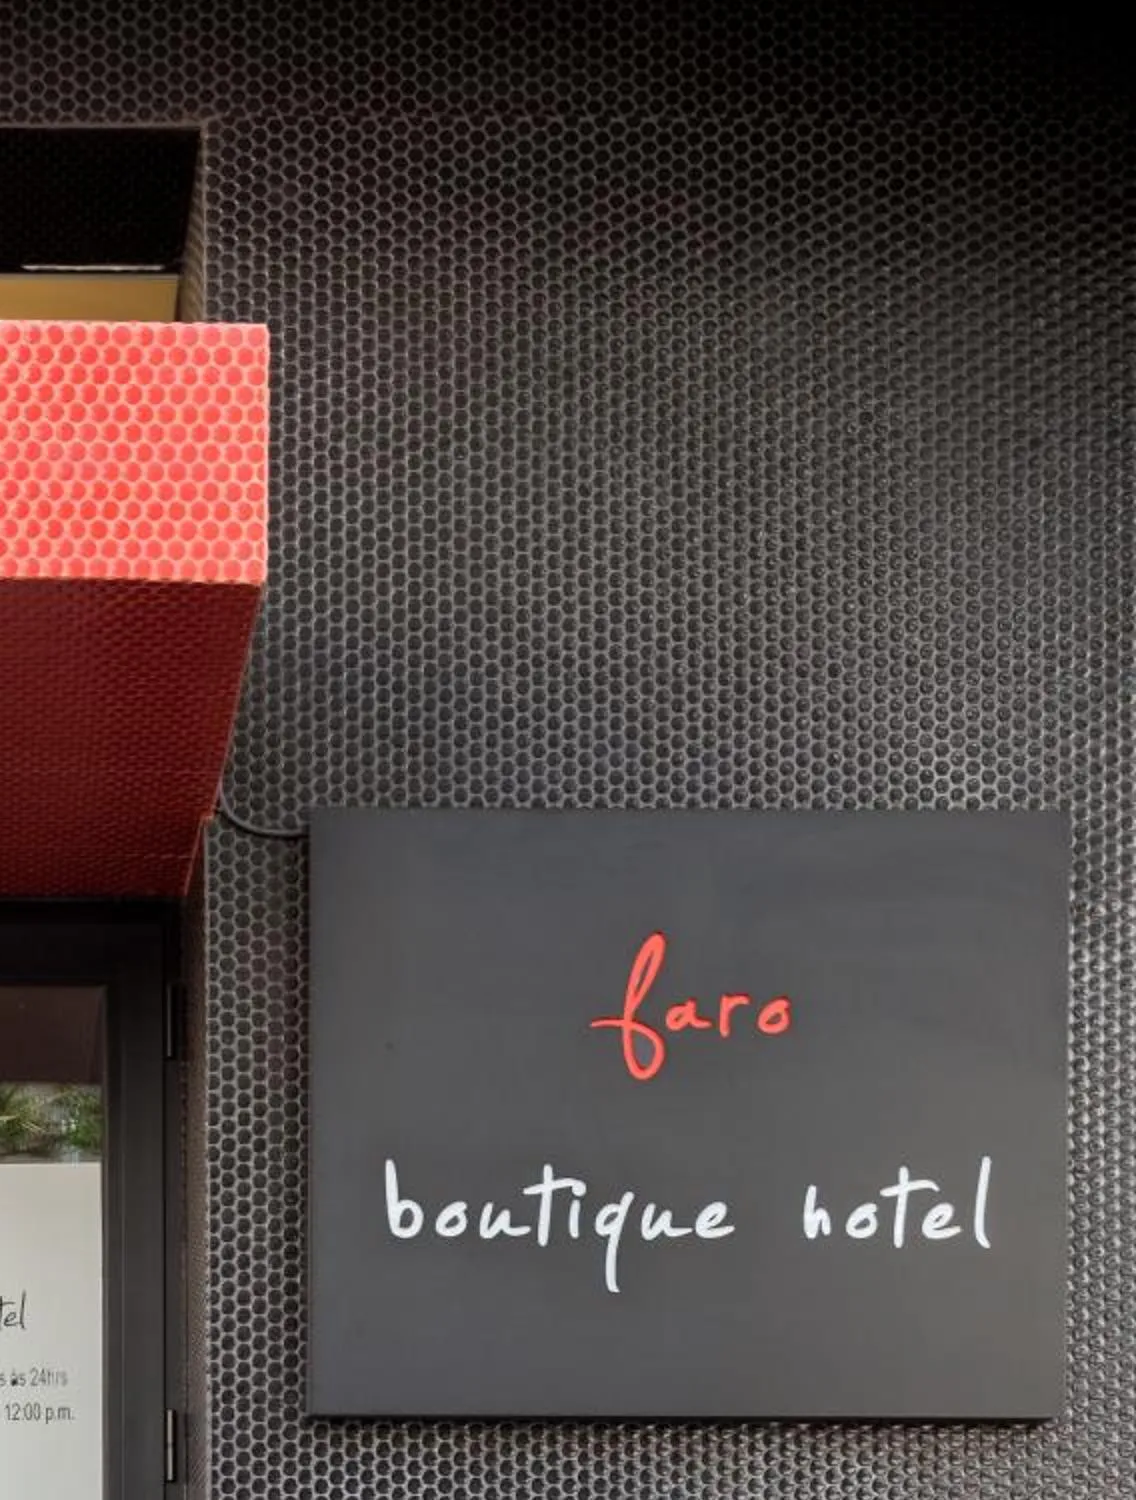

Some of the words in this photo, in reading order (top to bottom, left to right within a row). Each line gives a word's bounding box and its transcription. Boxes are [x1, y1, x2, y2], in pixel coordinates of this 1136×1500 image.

[590, 932, 791, 1080] faro
[384, 1158, 735, 1293] boutique
[803, 1156, 991, 1249] hotel
[4, 1402, 41, 1421] 12:00
[44, 1406, 76, 1424] p.m.
[30, 1367, 68, 1387] 24hrs
